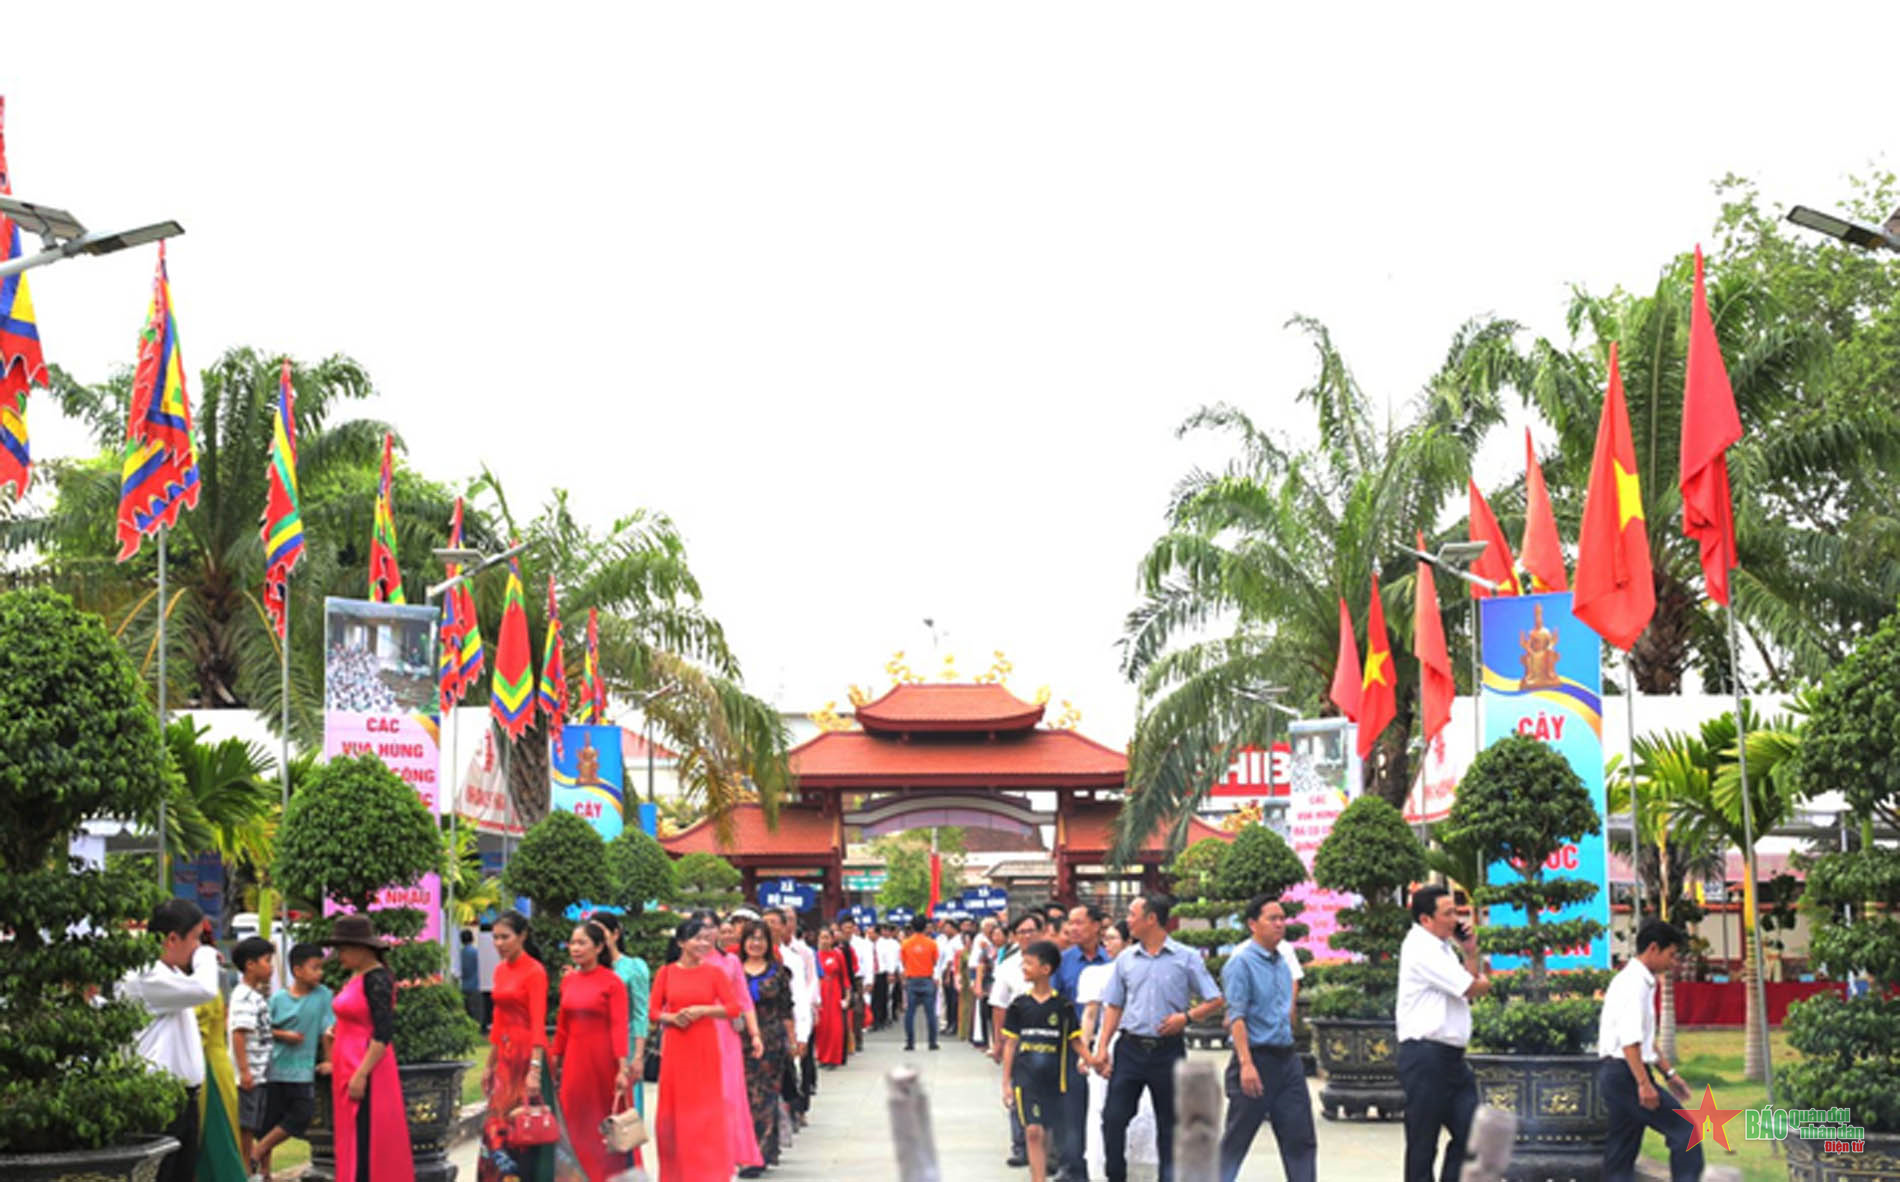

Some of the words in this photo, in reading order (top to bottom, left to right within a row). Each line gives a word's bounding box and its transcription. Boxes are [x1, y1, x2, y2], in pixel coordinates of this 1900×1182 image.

[366, 716, 400, 734] CÁC
[1518, 711, 1565, 741] CÂY
[378, 738, 424, 759] HÙNG
[574, 800, 603, 818] CÂY
